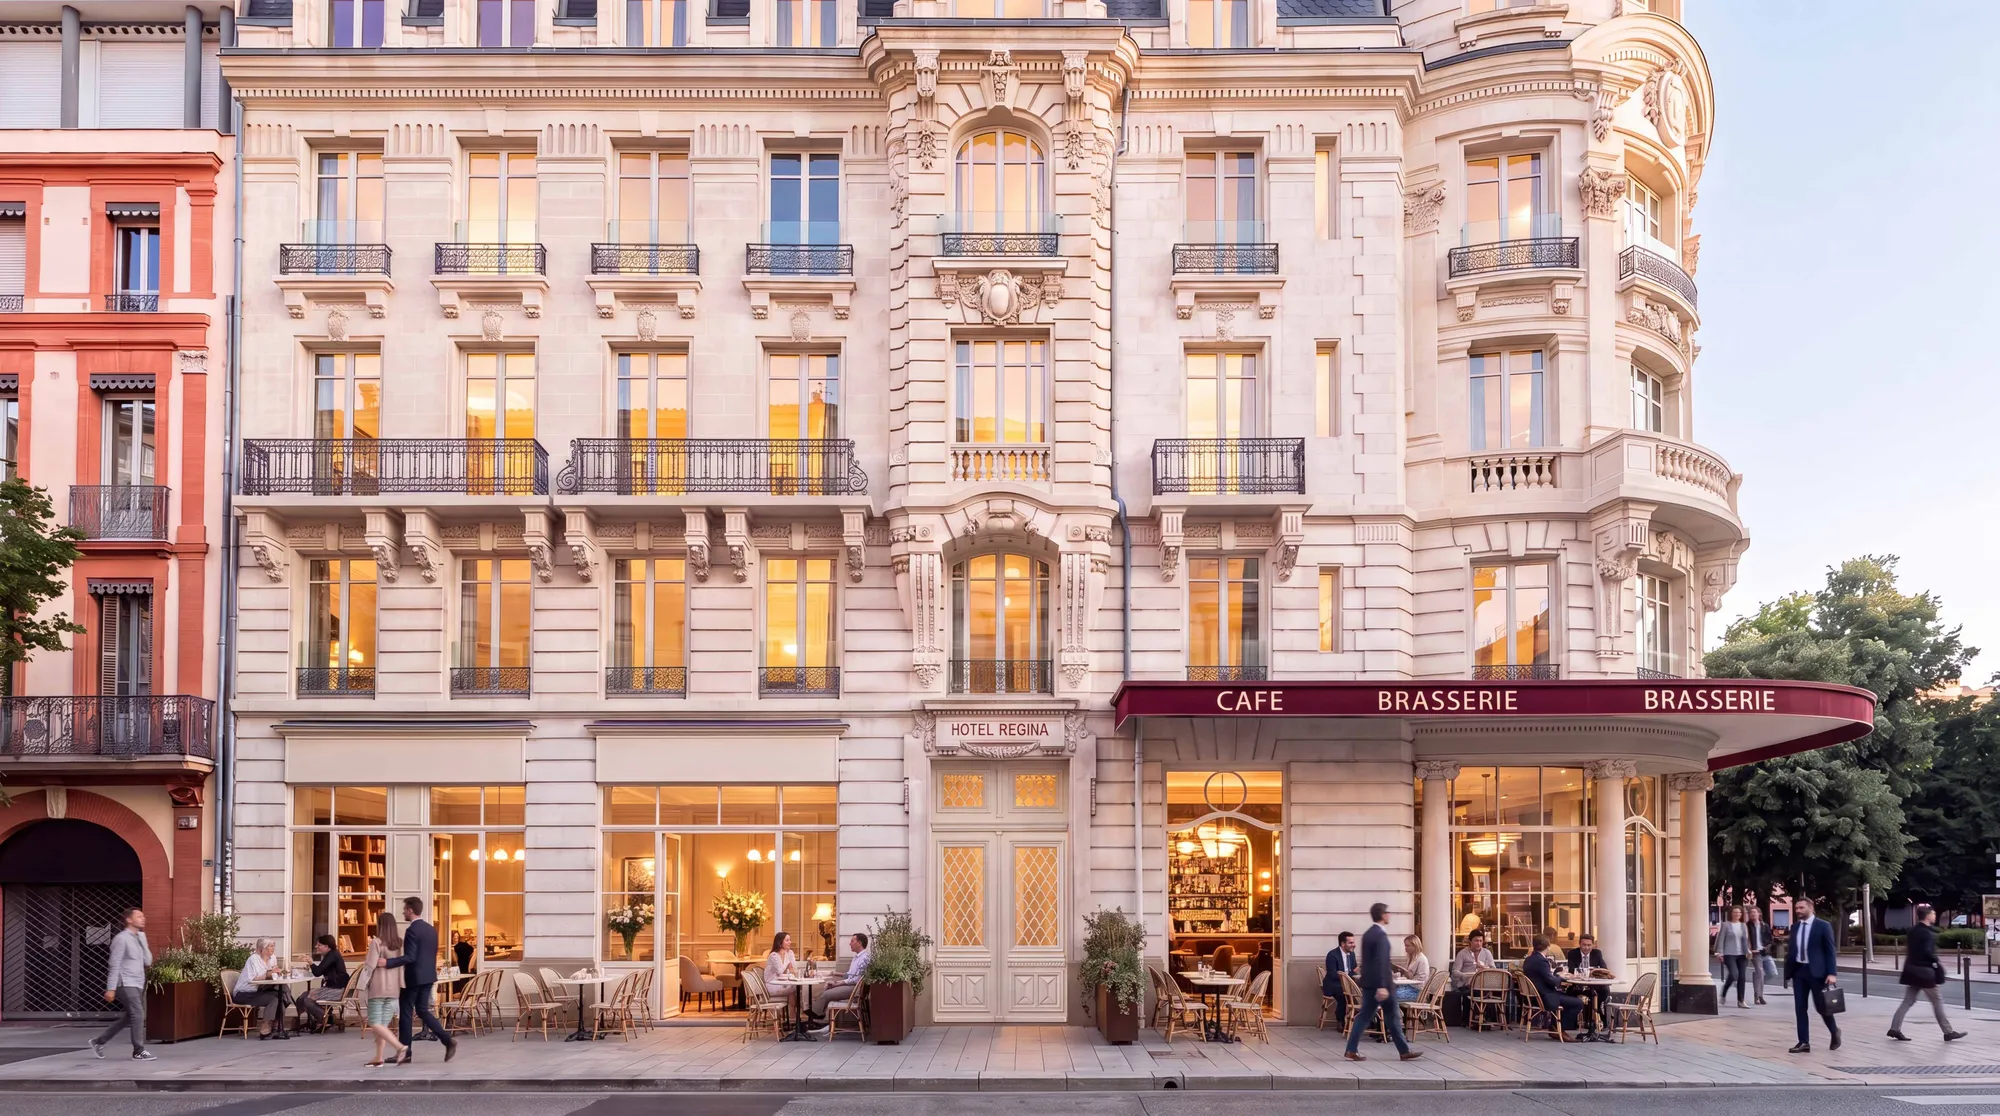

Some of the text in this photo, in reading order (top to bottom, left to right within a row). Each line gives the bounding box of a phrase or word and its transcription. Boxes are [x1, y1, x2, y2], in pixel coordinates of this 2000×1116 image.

[1217, 691, 1283, 711] CAFE
[1378, 691, 1518, 711] BRASSERIE
[1644, 690, 1776, 710] BRASSERIE
[951, 723, 1049, 736] HOTEL REGINA
